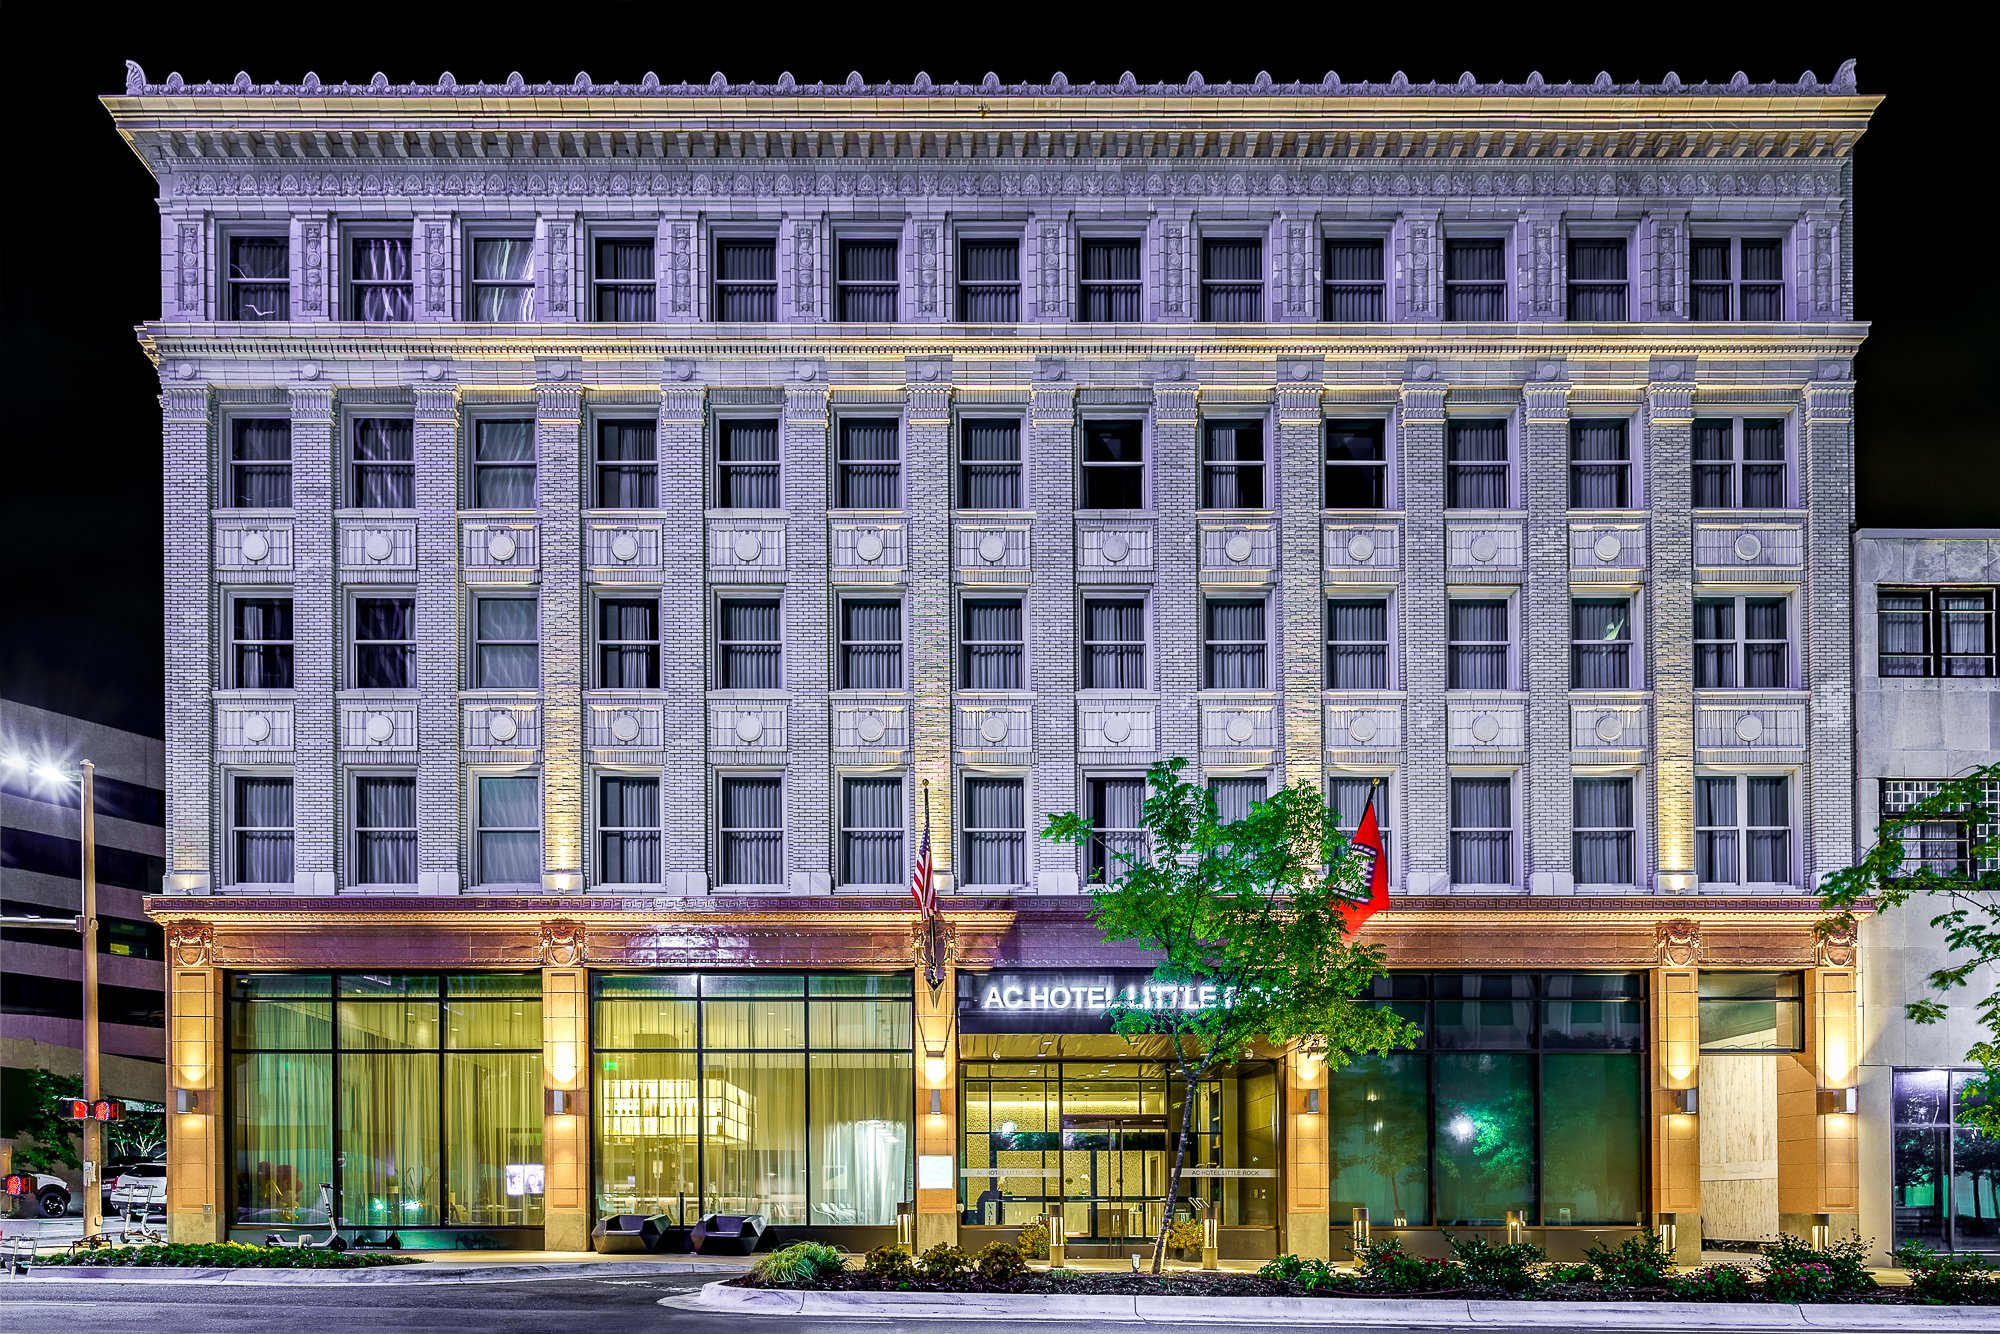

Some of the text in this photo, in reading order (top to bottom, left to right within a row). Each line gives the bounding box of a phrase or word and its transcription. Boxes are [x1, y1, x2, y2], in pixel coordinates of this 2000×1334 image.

[982, 986, 1023, 1009] AC
[1030, 986, 1119, 1009] HOTEL
[1128, 985, 1217, 1009] LITTLE
